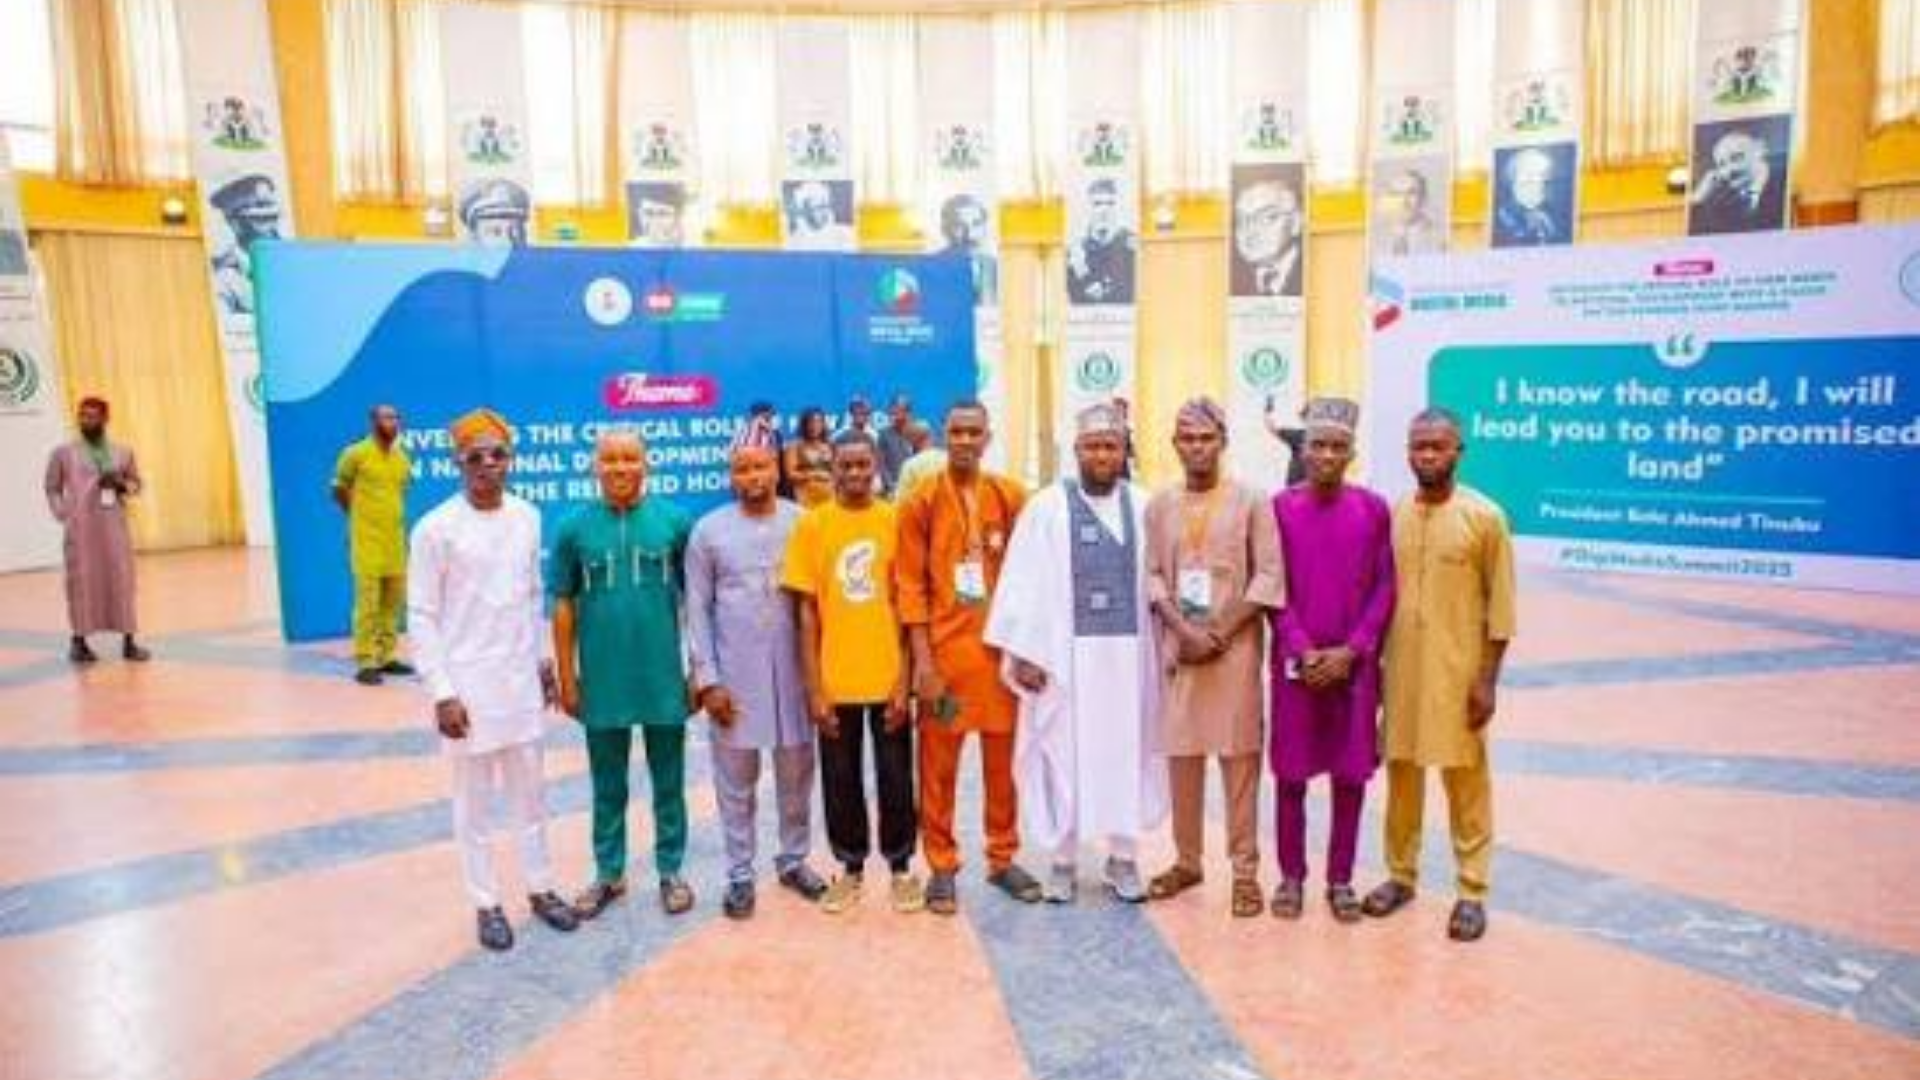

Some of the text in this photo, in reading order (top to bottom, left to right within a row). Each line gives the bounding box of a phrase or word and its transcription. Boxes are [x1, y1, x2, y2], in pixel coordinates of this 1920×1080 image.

[1496, 375, 1897, 410] I know the road, I will
[526, 424, 573, 445] THE
[1472, 415, 1920, 450] lead you to the promised
